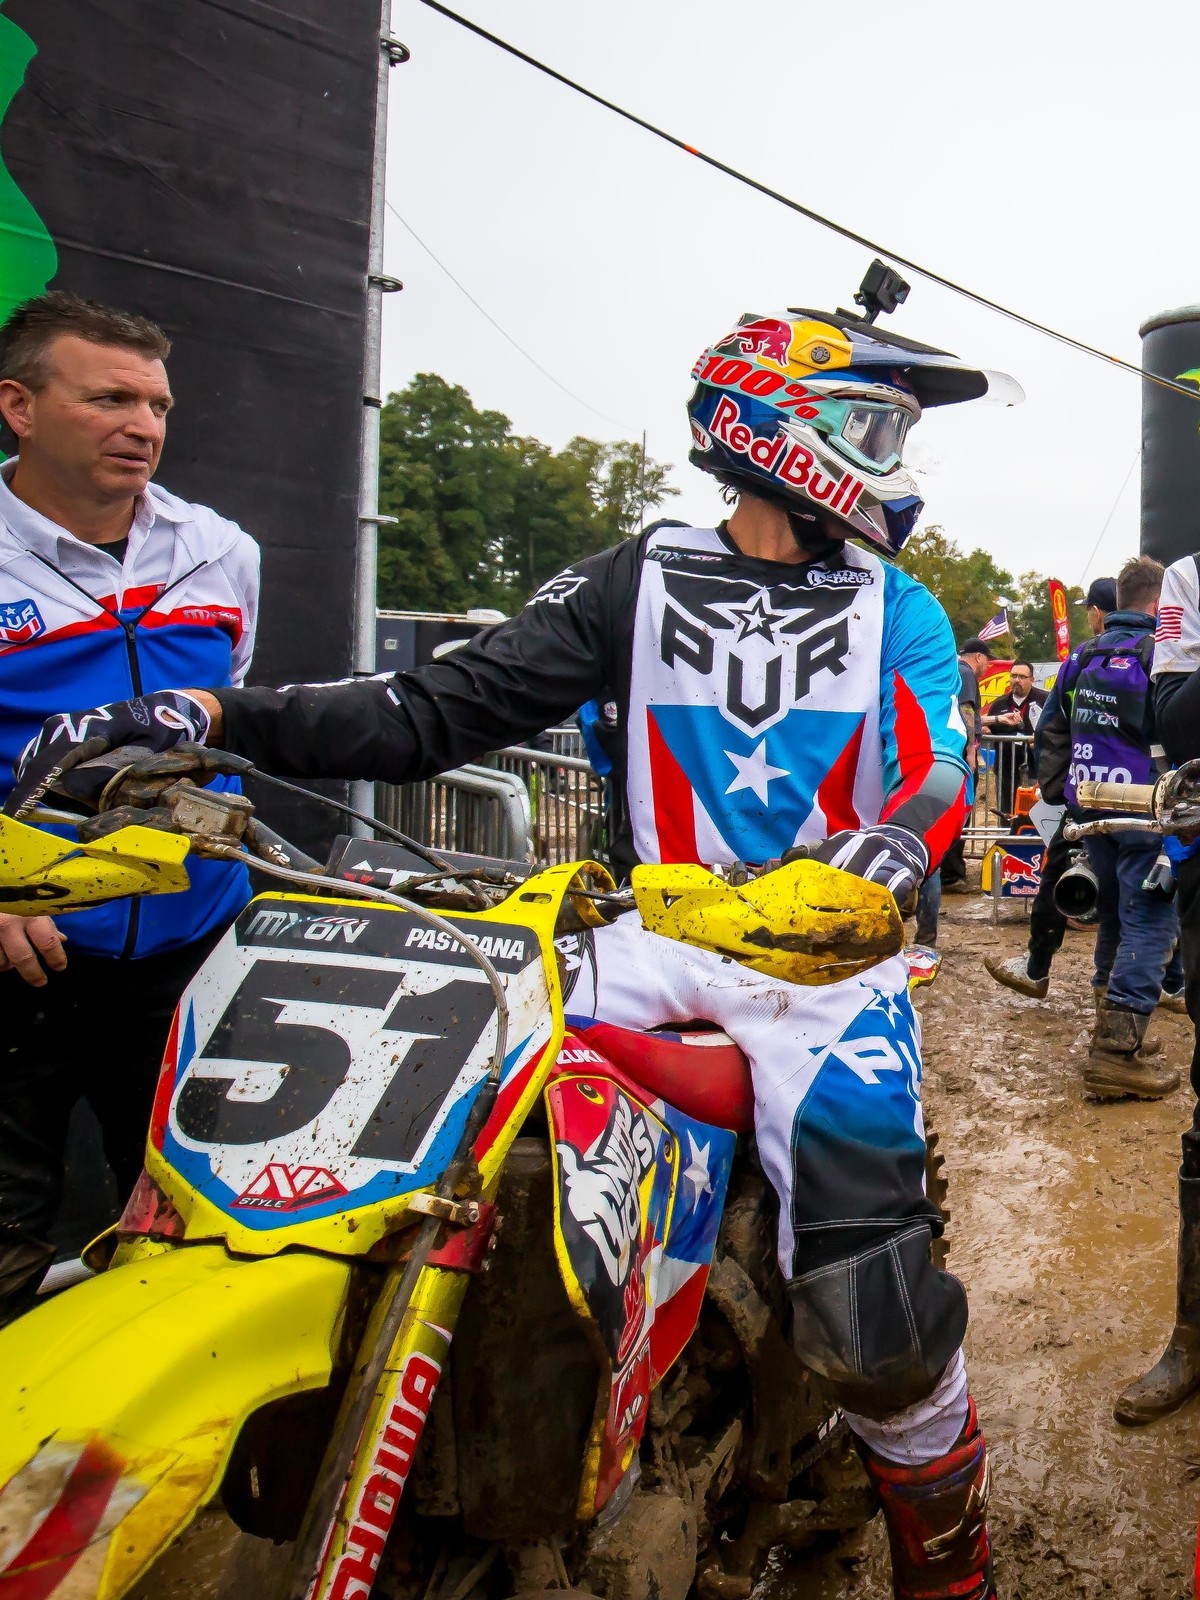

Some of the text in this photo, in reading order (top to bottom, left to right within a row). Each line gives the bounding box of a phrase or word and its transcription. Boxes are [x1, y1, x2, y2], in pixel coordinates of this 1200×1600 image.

[700, 355, 828, 421] 100%
[709, 394, 866, 517] Red Bull
[0, 603, 37, 629] UR
[660, 602, 850, 729] PUR
[1079, 687, 1118, 705] MONSTER
[1073, 743, 1094, 760] 28
[176, 958, 500, 1164] 51
[556, 1049, 605, 1065] ZUKI
[238, 1197, 288, 1208] STYLE
